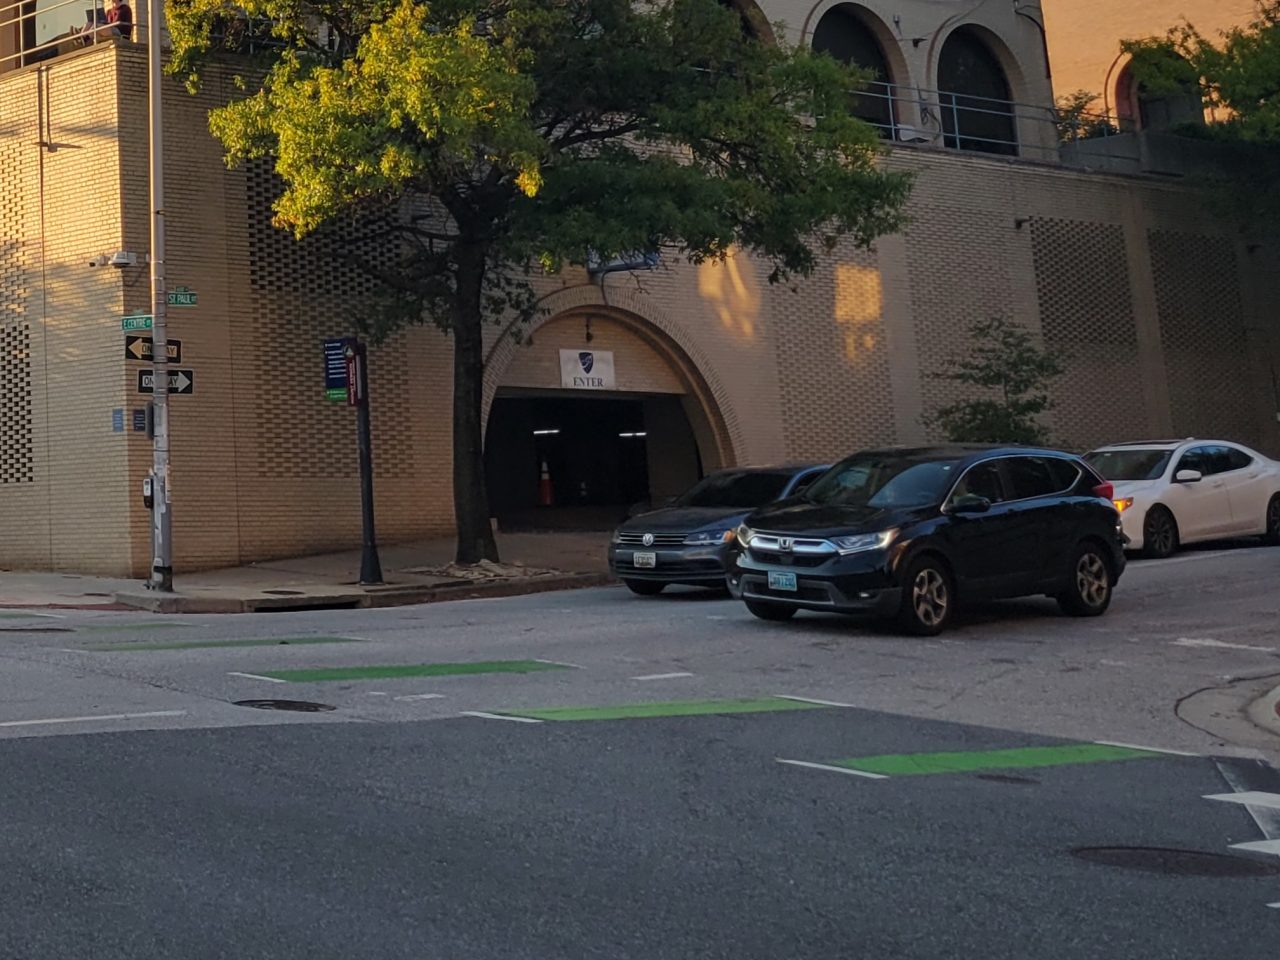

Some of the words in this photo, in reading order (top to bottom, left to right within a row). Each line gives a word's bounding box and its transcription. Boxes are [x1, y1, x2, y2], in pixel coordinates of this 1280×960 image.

[177, 294, 191, 304] PAUL
[128, 318, 146, 328] CENTRE
[573, 376, 604, 388] ENTER
